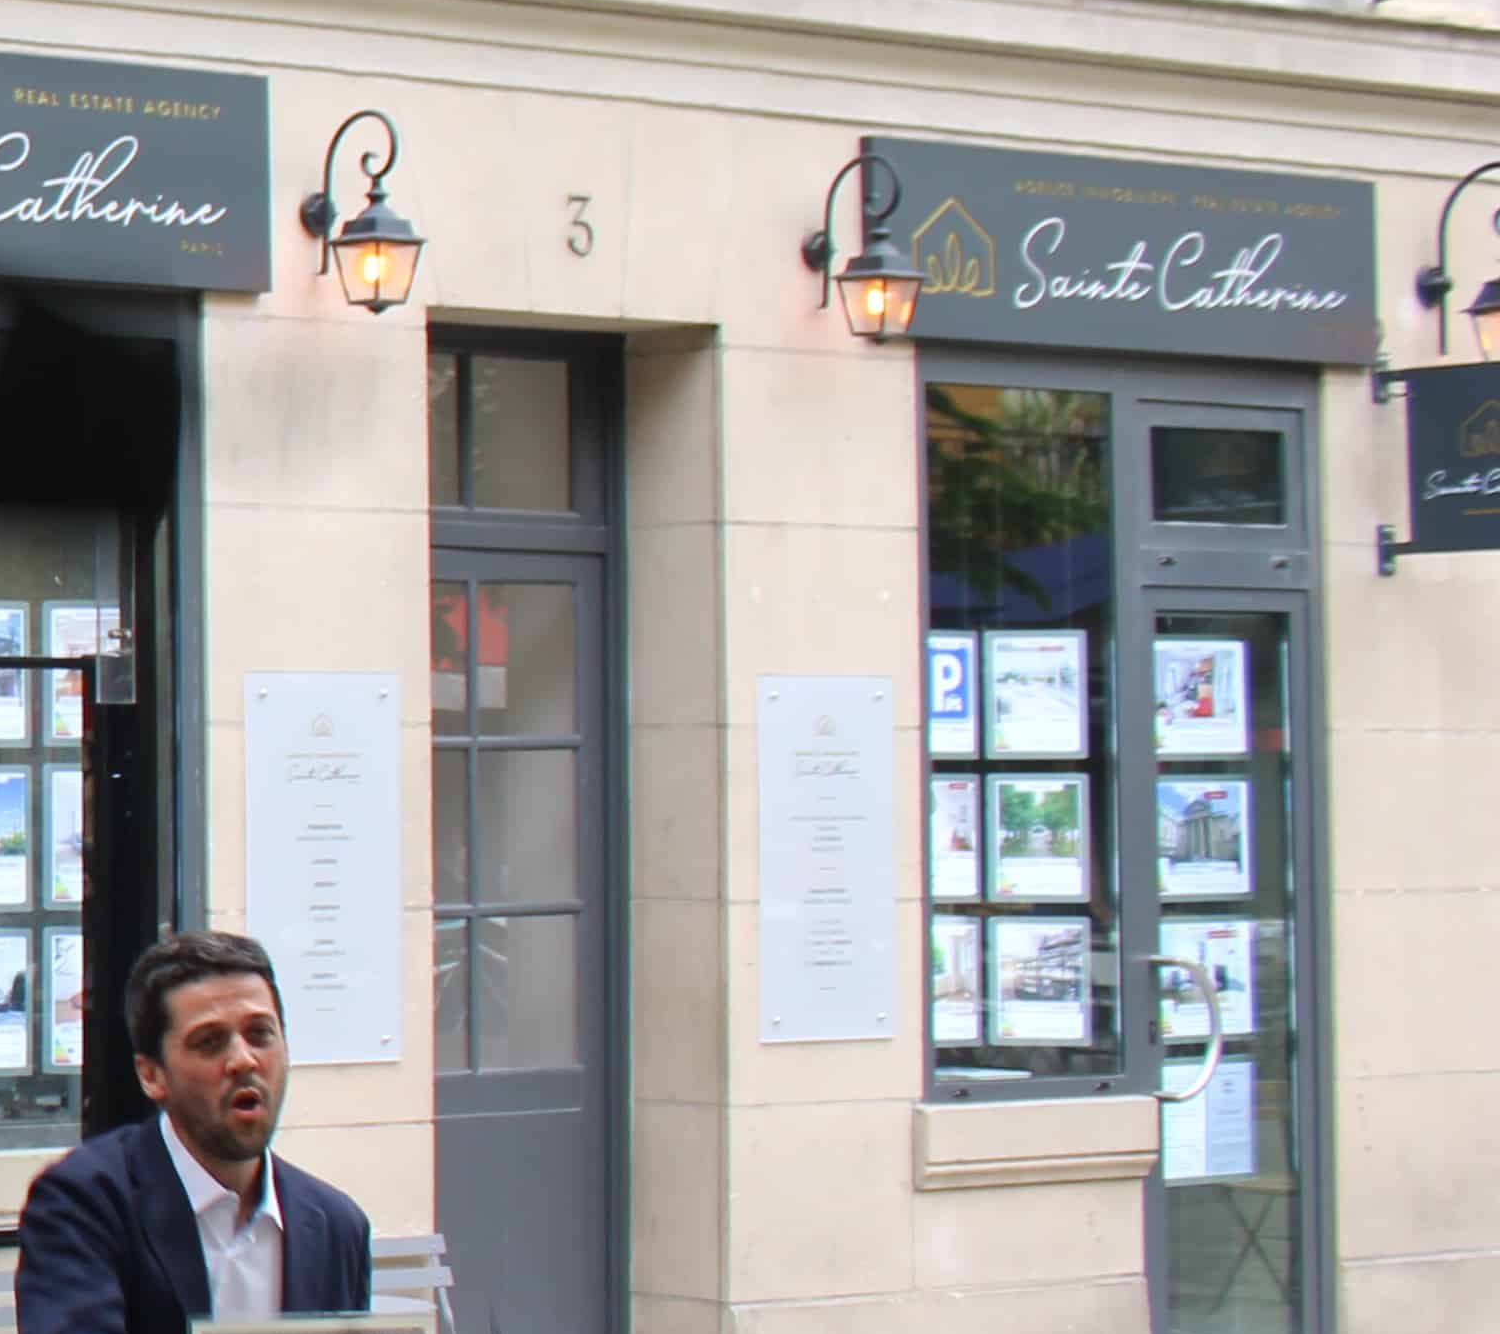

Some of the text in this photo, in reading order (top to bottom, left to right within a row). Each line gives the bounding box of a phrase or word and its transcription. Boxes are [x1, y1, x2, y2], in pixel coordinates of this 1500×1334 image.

[12, 87, 223, 120] REAL ESTATE AGENCY
[565, 192, 594, 257] 3
[1013, 216, 1348, 312] Sainte Catherine
